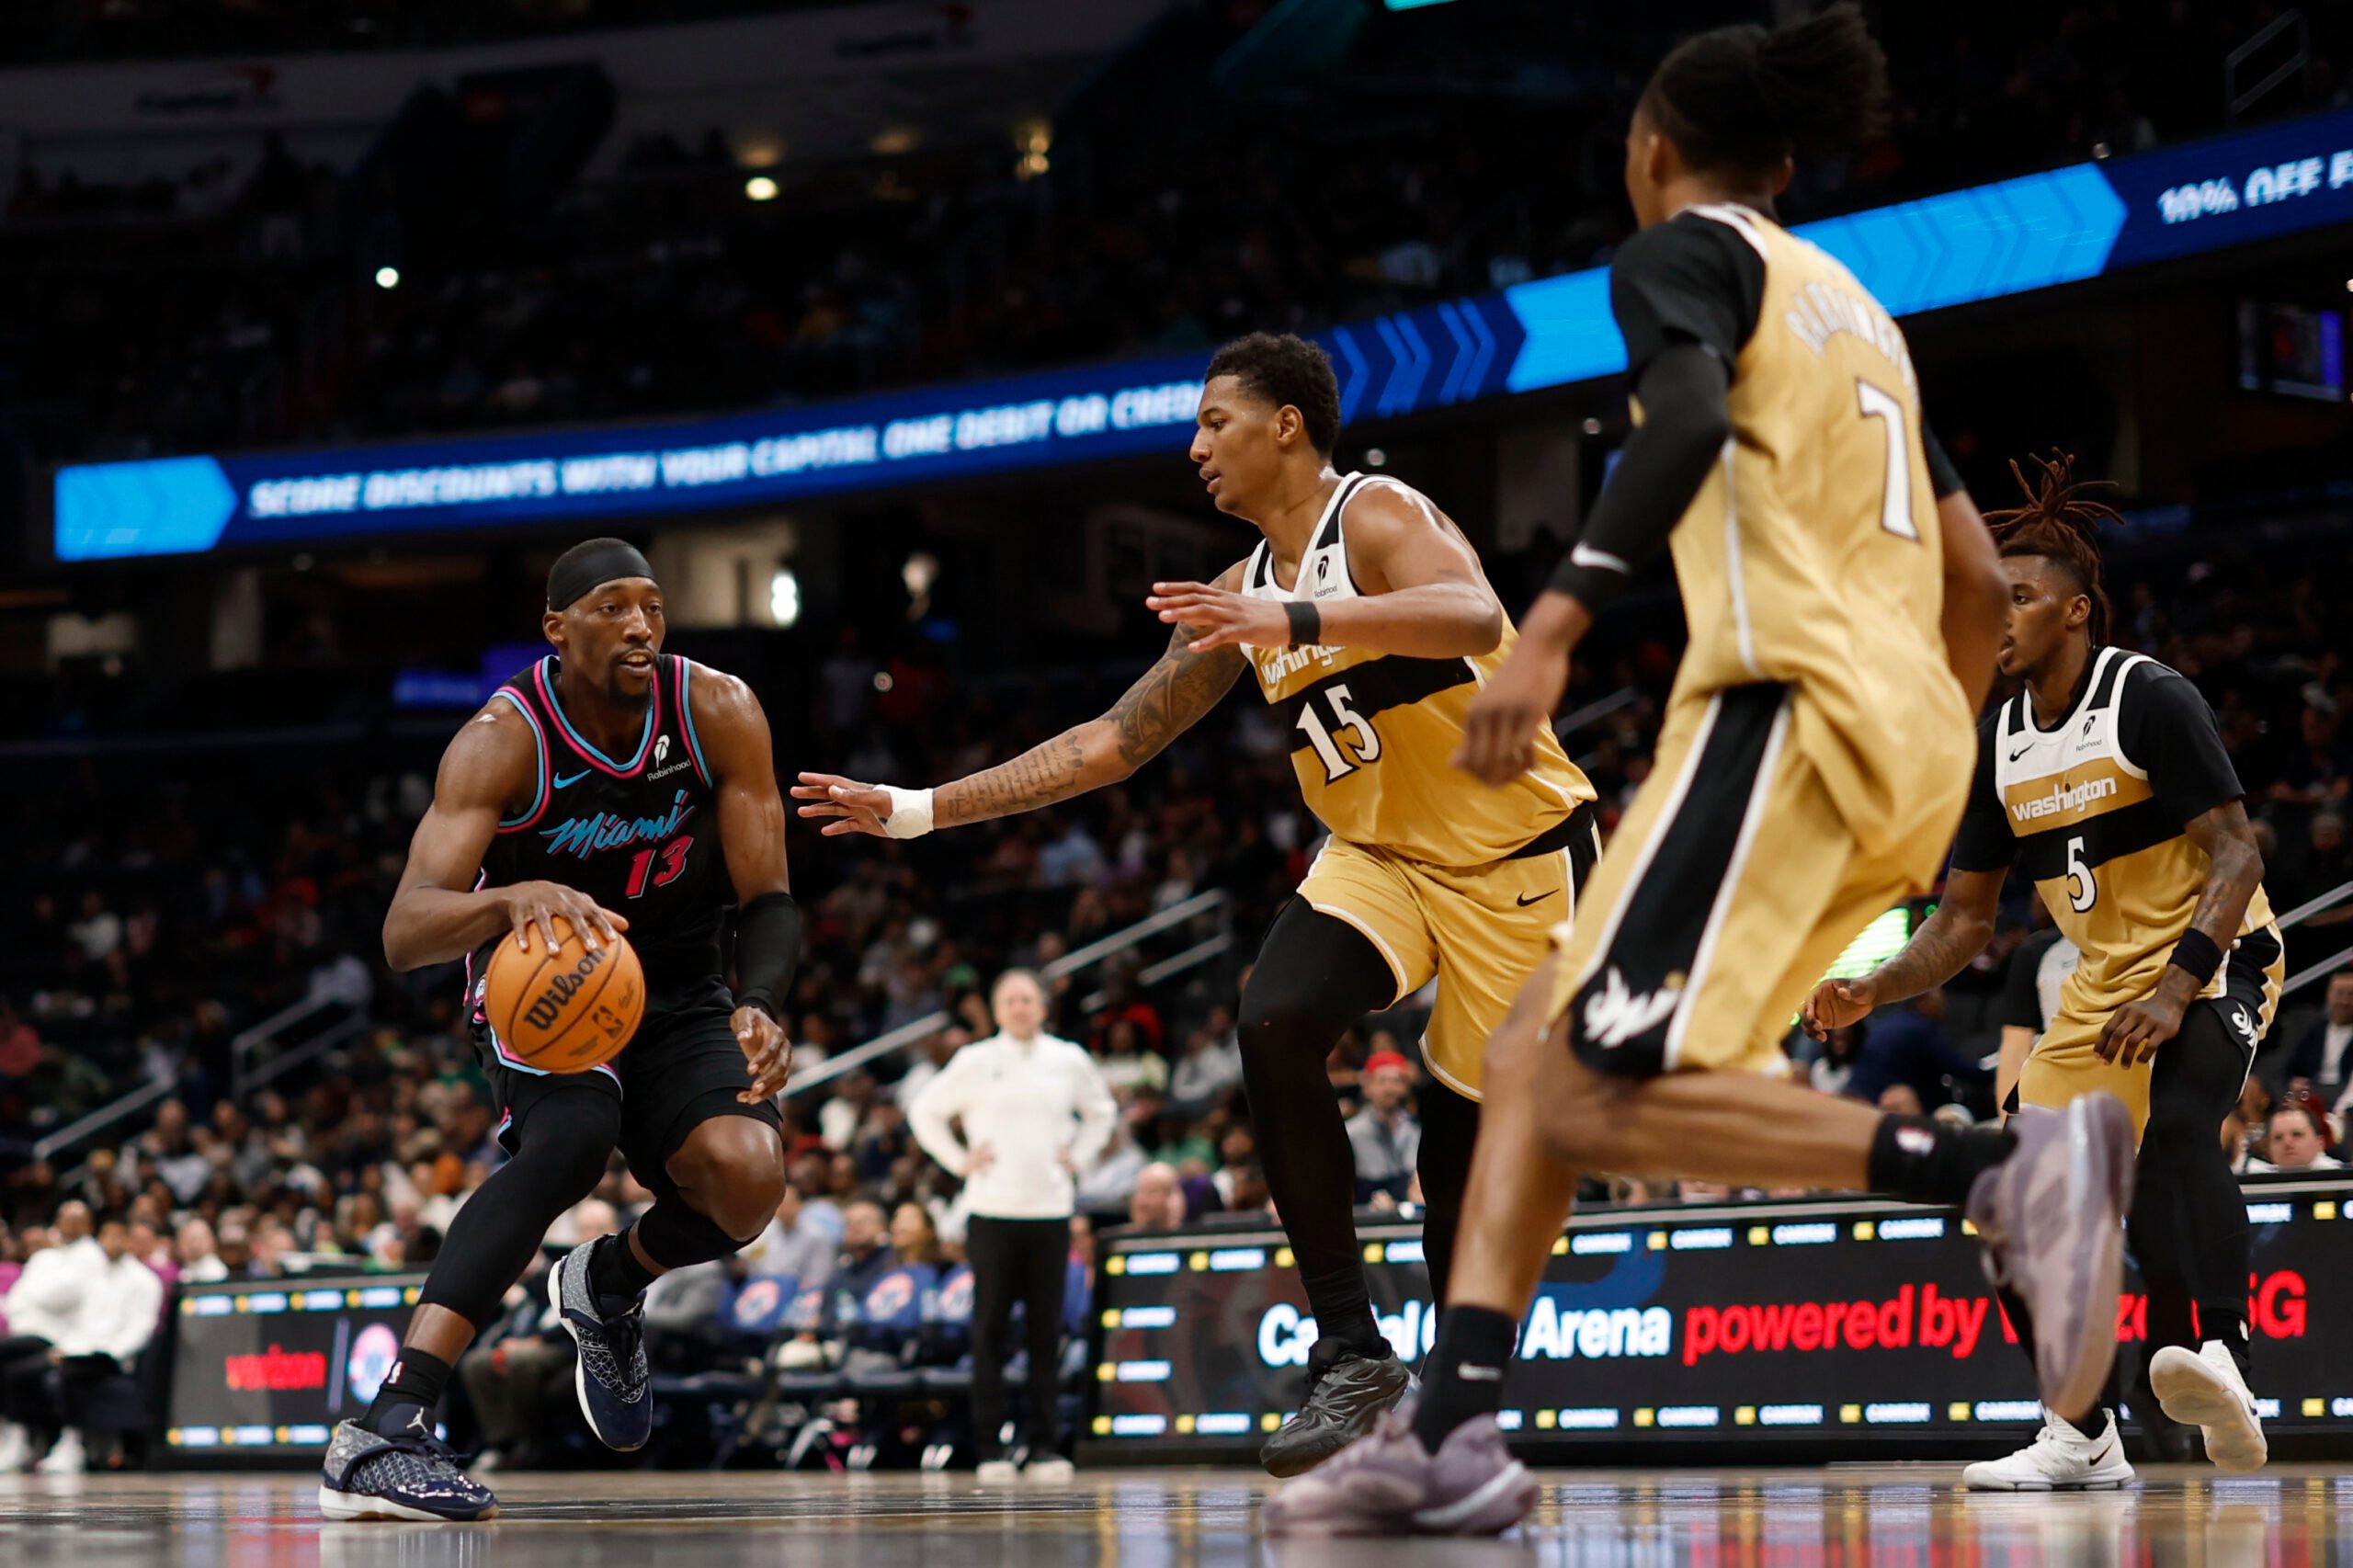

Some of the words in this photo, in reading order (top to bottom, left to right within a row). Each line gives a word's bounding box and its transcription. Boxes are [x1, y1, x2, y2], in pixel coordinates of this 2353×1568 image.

[2245, 156, 2324, 206] OFF
[251, 474, 361, 519] SCORE
[365, 460, 556, 509] DISCOUNTS
[562, 451, 656, 494] WITH
[661, 442, 749, 487] YOUR
[752, 425, 877, 477] CAPITAL
[883, 415, 952, 458] ONE
[957, 401, 1054, 449] DEBIT
[1057, 394, 1108, 437] OR
[1854, 375, 1921, 544] 7
[646, 758, 692, 782] Robinhood
[1293, 682, 1382, 787] 15
[539, 789, 697, 861] Miami
[2011, 777, 2118, 823] washington
[624, 835, 695, 900] 13
[2066, 835, 2098, 914] 5
[523, 947, 608, 1031] Wilson
[1519, 1295, 1672, 1360] Arena
[1682, 1283, 1915, 1369] powered
[1918, 1282, 1990, 1359] by
